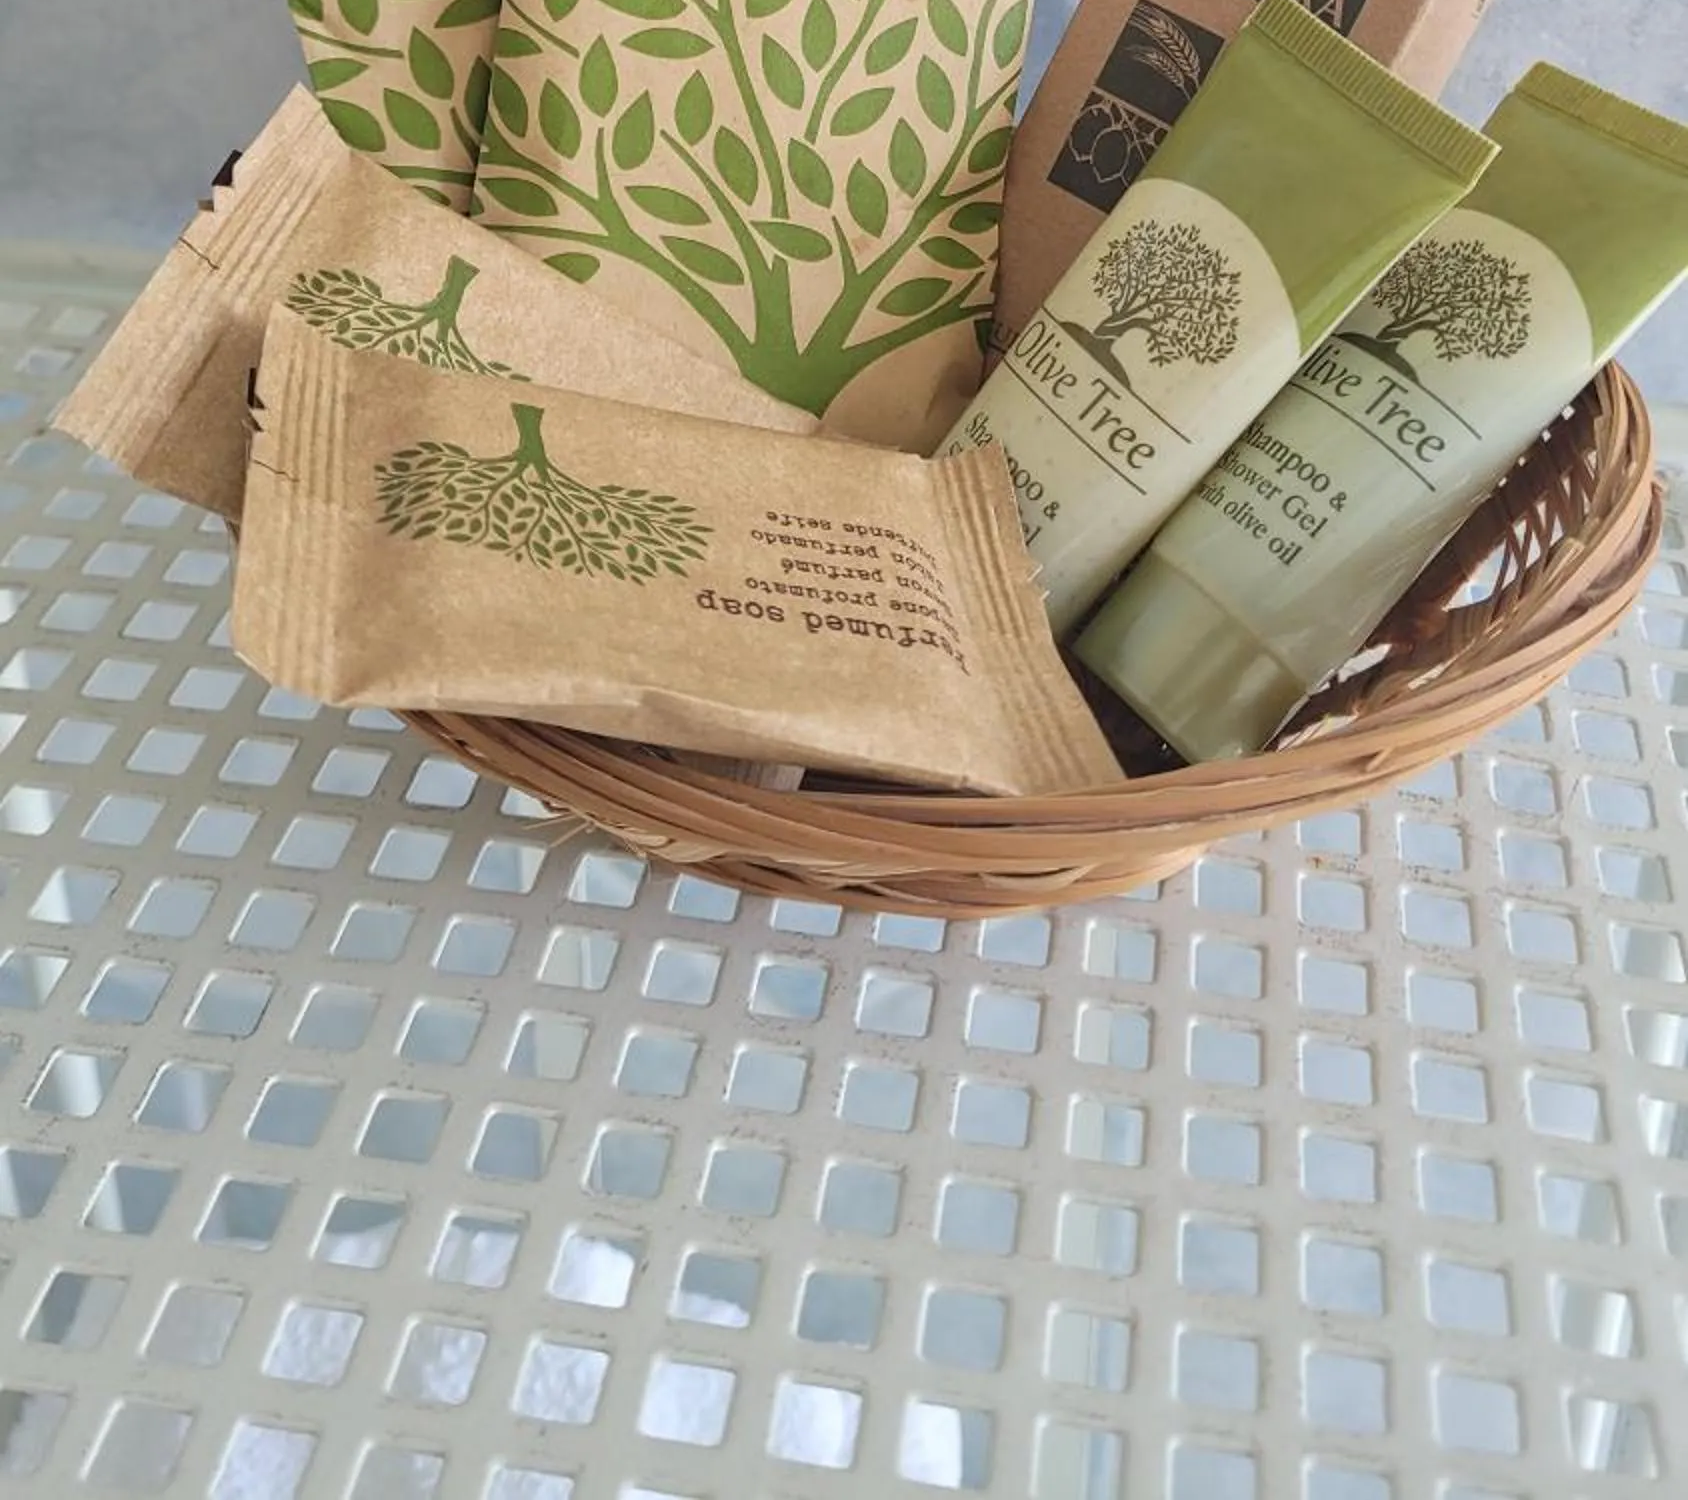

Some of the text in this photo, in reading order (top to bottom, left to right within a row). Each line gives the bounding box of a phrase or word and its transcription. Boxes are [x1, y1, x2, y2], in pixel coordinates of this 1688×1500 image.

[1014, 320, 1156, 470] Olive Tree
[1299, 344, 1446, 463] live Tree
[1043, 501, 1061, 521] &
[1281, 494, 1329, 538] Gel
[1329, 491, 1348, 513] &
[751, 529, 880, 560] perfumado
[1223, 499, 1269, 540] olive
[1268, 537, 1303, 566] oil
[781, 557, 885, 584] parfumé
[696, 589, 785, 623] soap
[745, 576, 878, 607] profumato
